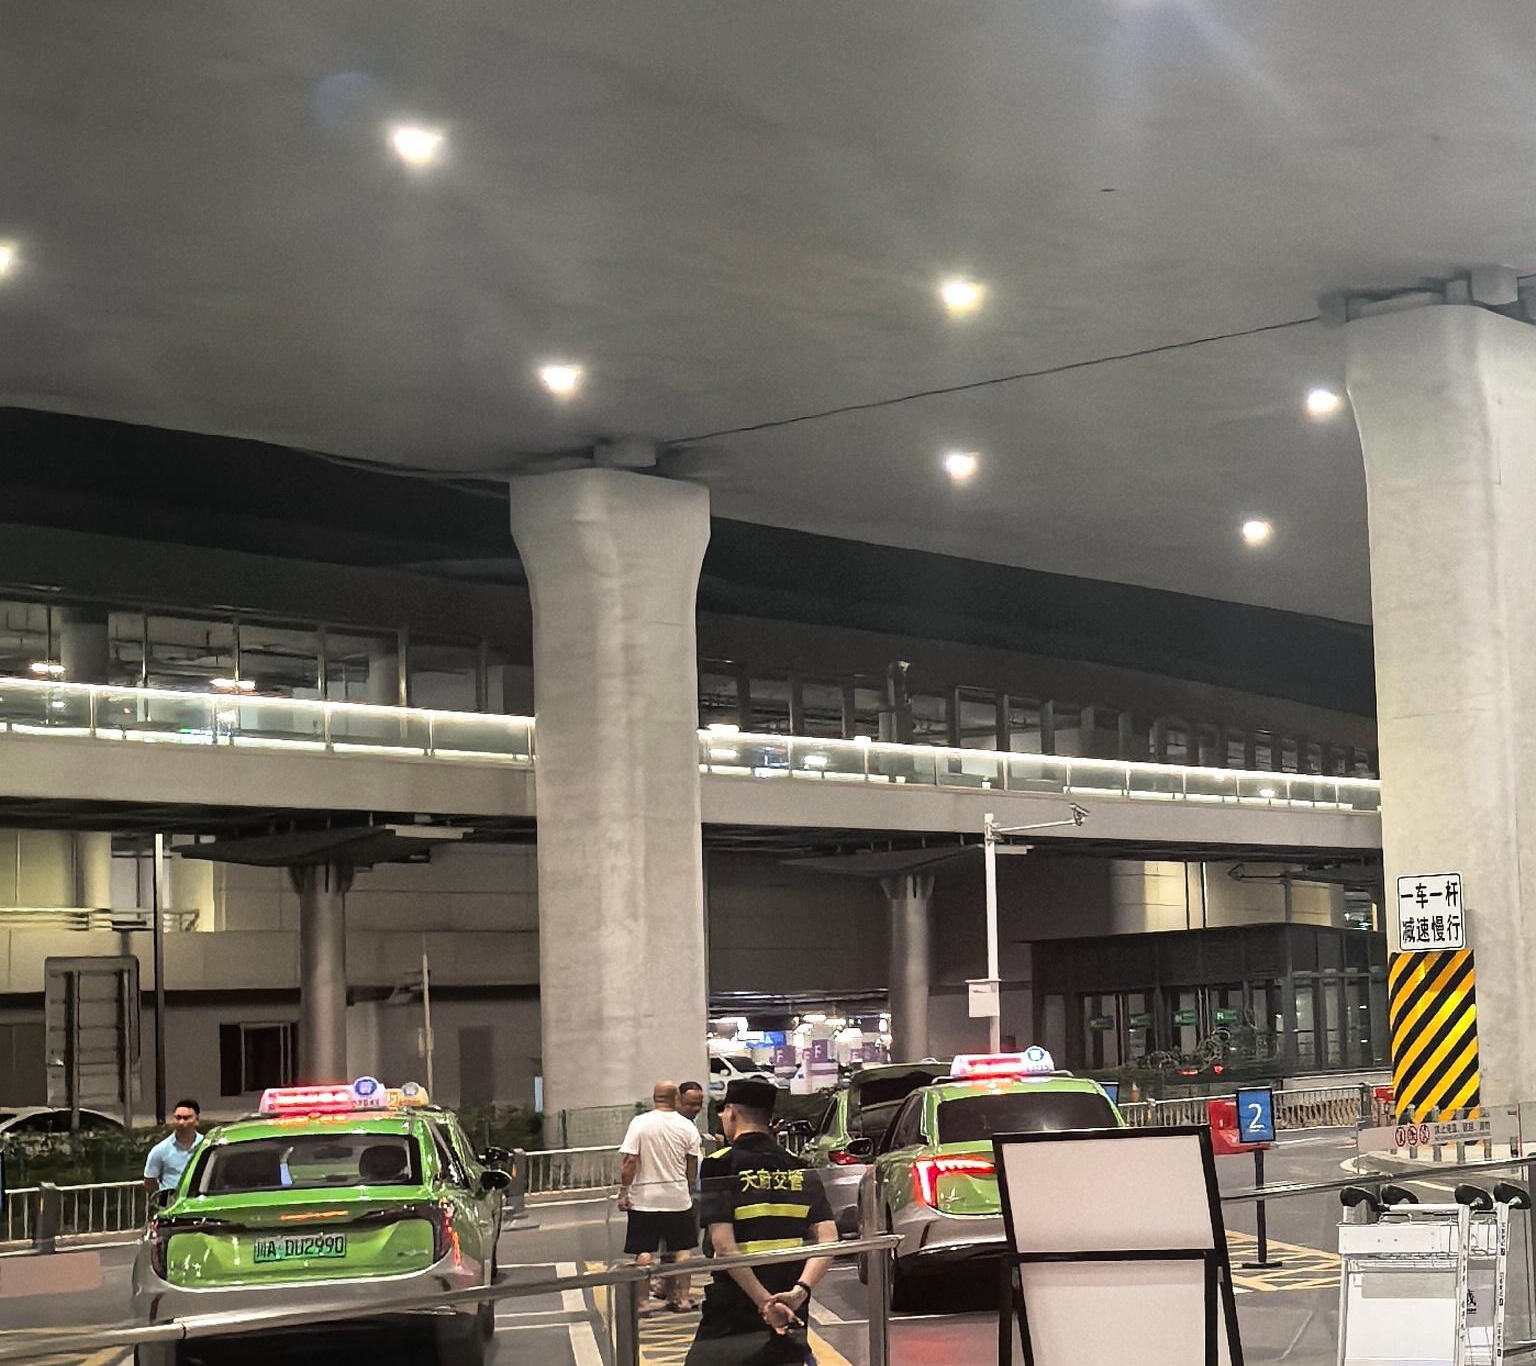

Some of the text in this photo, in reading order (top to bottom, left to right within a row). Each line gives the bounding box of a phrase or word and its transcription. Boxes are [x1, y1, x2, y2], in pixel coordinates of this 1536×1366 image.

[1401, 880, 1458, 909] 一车一杆
[1402, 914, 1460, 943] 减速慢行
[1248, 1103, 1265, 1129] 2
[738, 1169, 804, 1193] 天府交管
